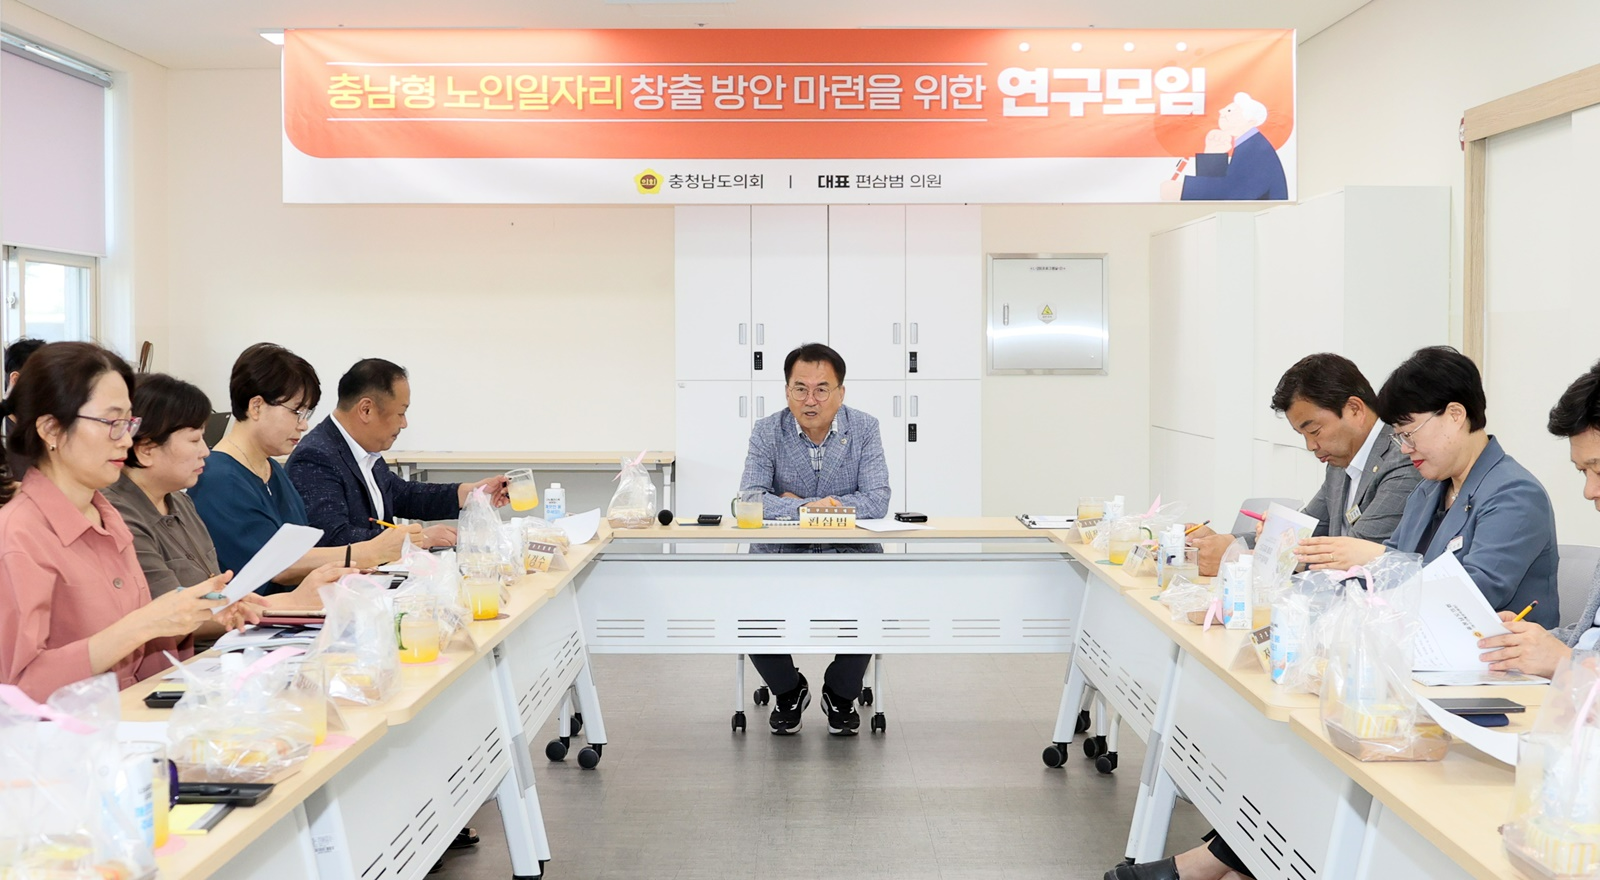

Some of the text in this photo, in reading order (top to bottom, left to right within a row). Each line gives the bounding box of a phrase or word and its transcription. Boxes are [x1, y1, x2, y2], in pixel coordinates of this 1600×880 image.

[326, 66, 1207, 117] 충남형 노인일자리 창출 방안 마련을 위한 연구모임
[668, 174, 764, 189] 충청남도의회
[817, 174, 942, 189] 대표 편삼범 의원
